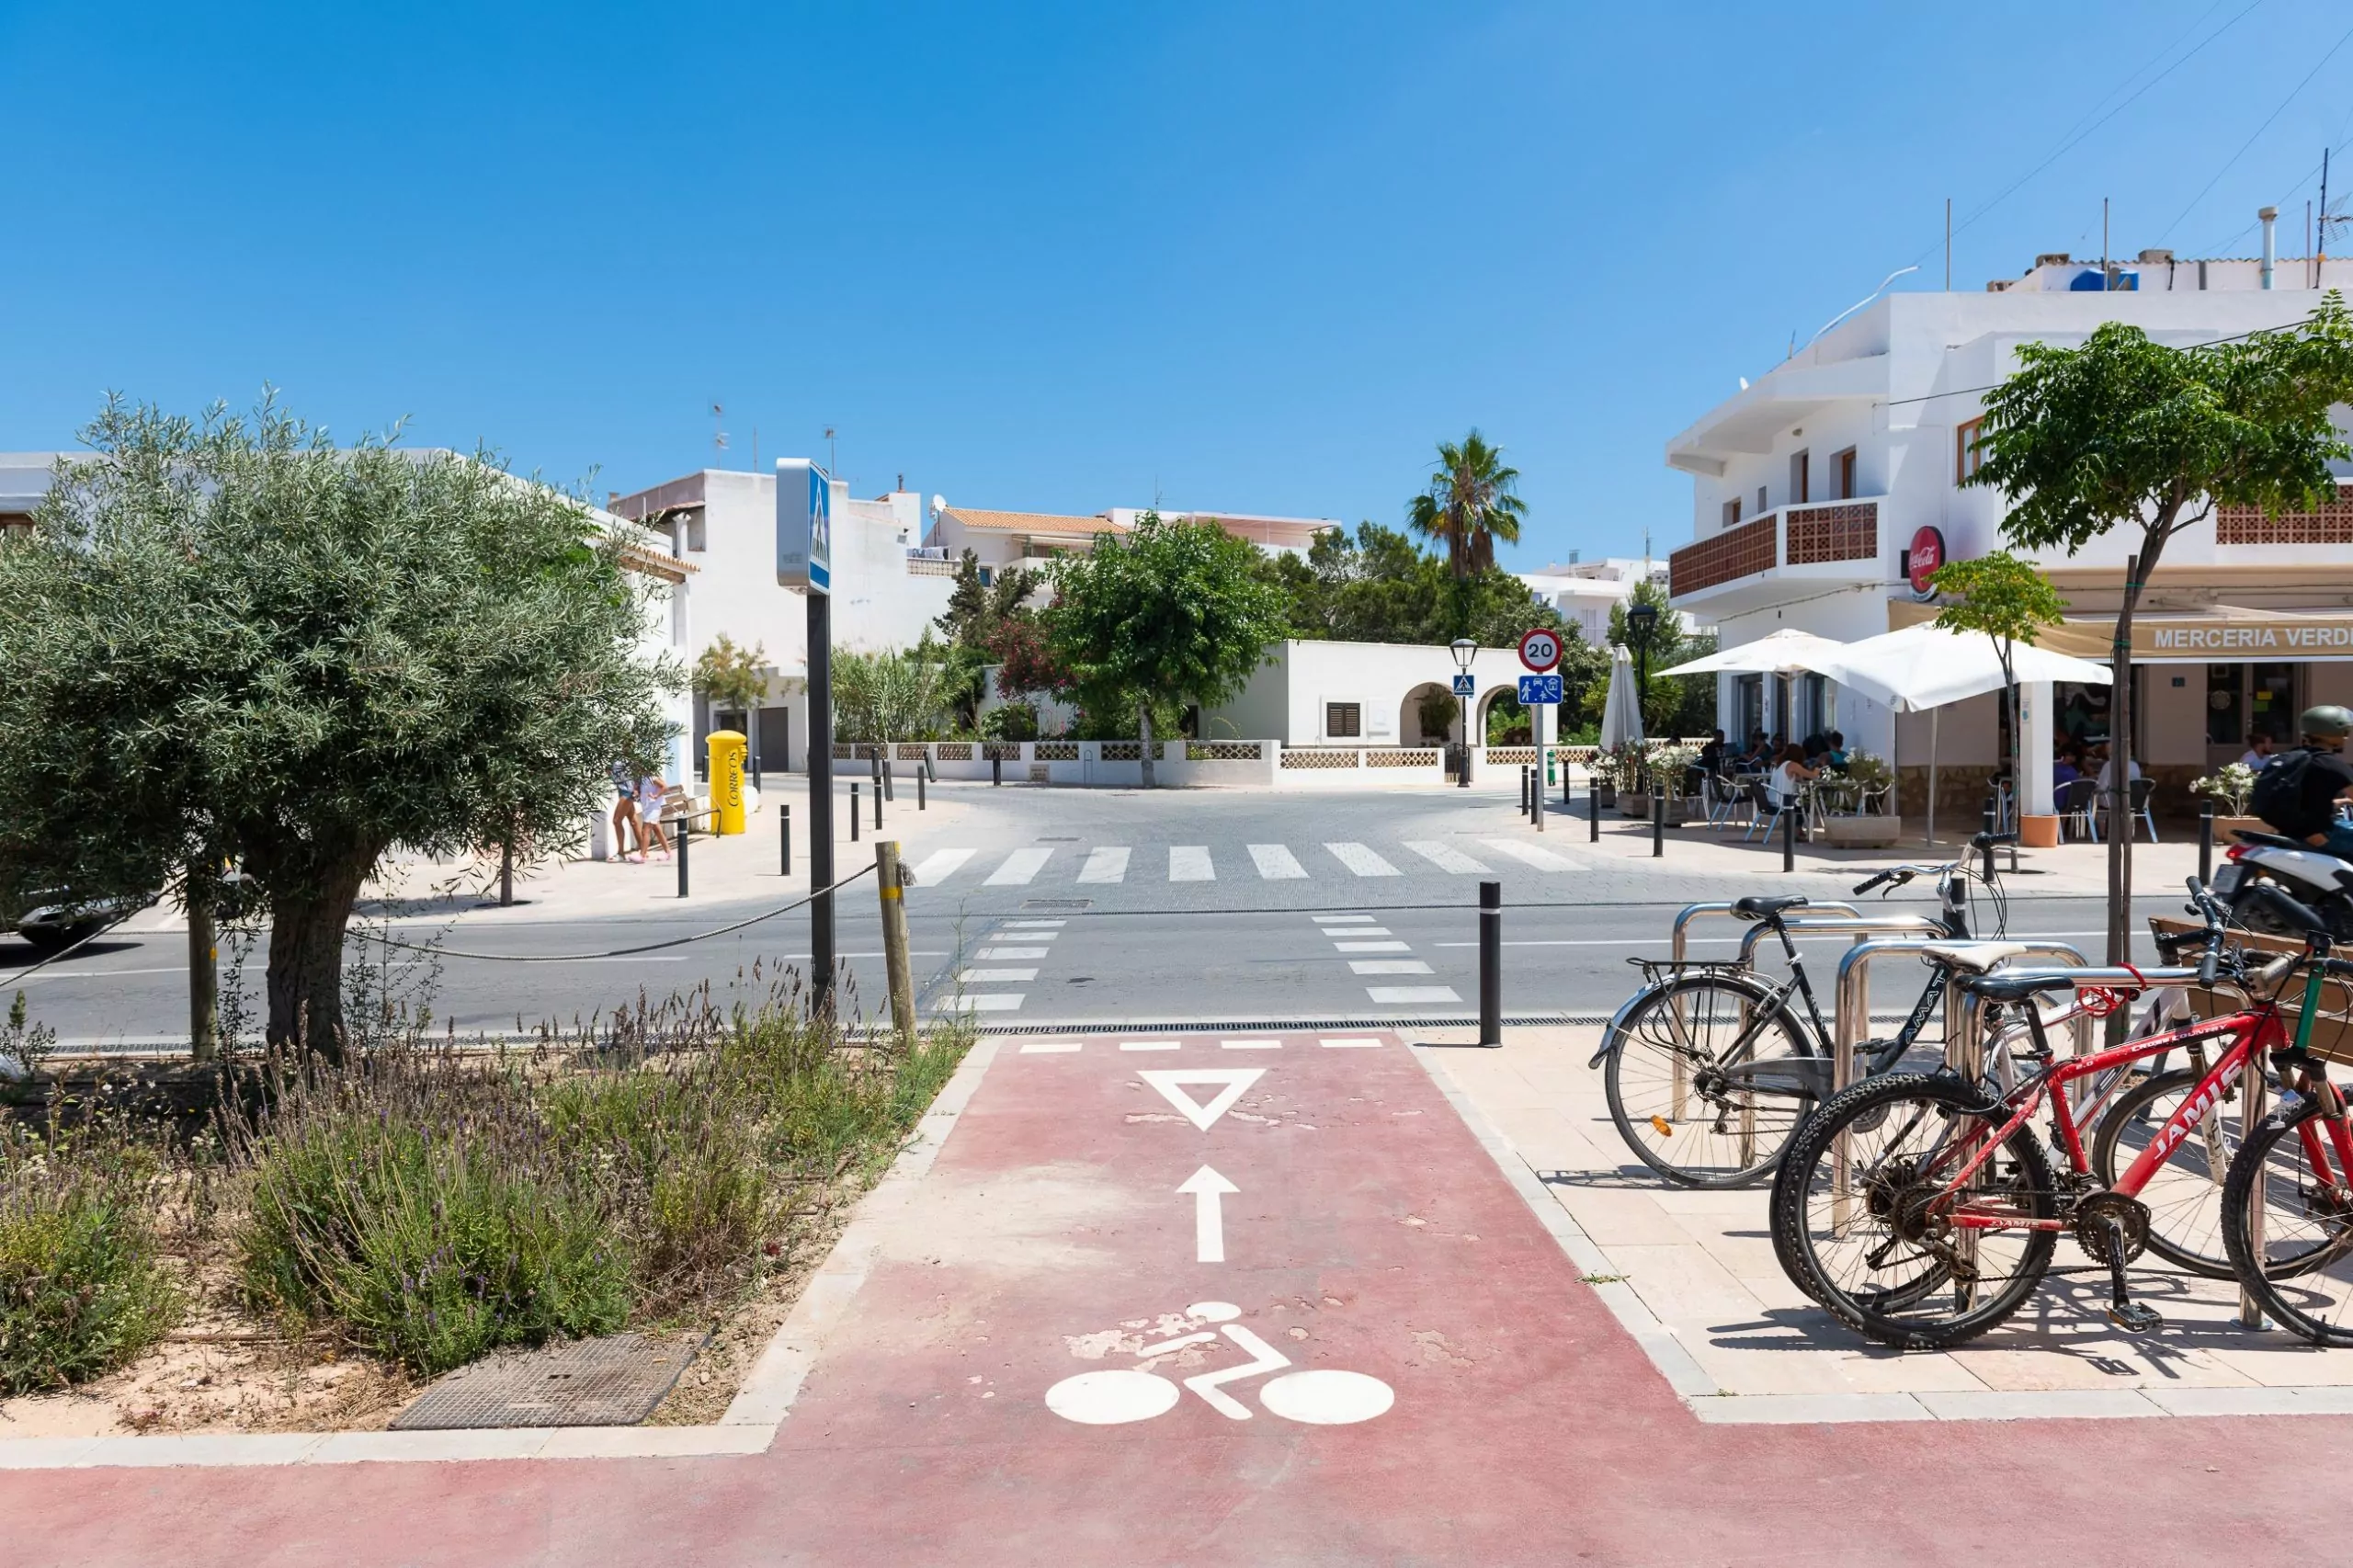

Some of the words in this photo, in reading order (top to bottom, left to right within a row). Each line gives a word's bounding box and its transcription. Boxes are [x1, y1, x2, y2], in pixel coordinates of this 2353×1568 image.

[2154, 628, 2278, 648] MERCERIA
[1529, 643, 1552, 658] 20
[727, 752, 739, 807] CORREOS
[2172, 1023, 2228, 1040] COUNTRY
[2154, 1059, 2243, 1161] JAMIS
